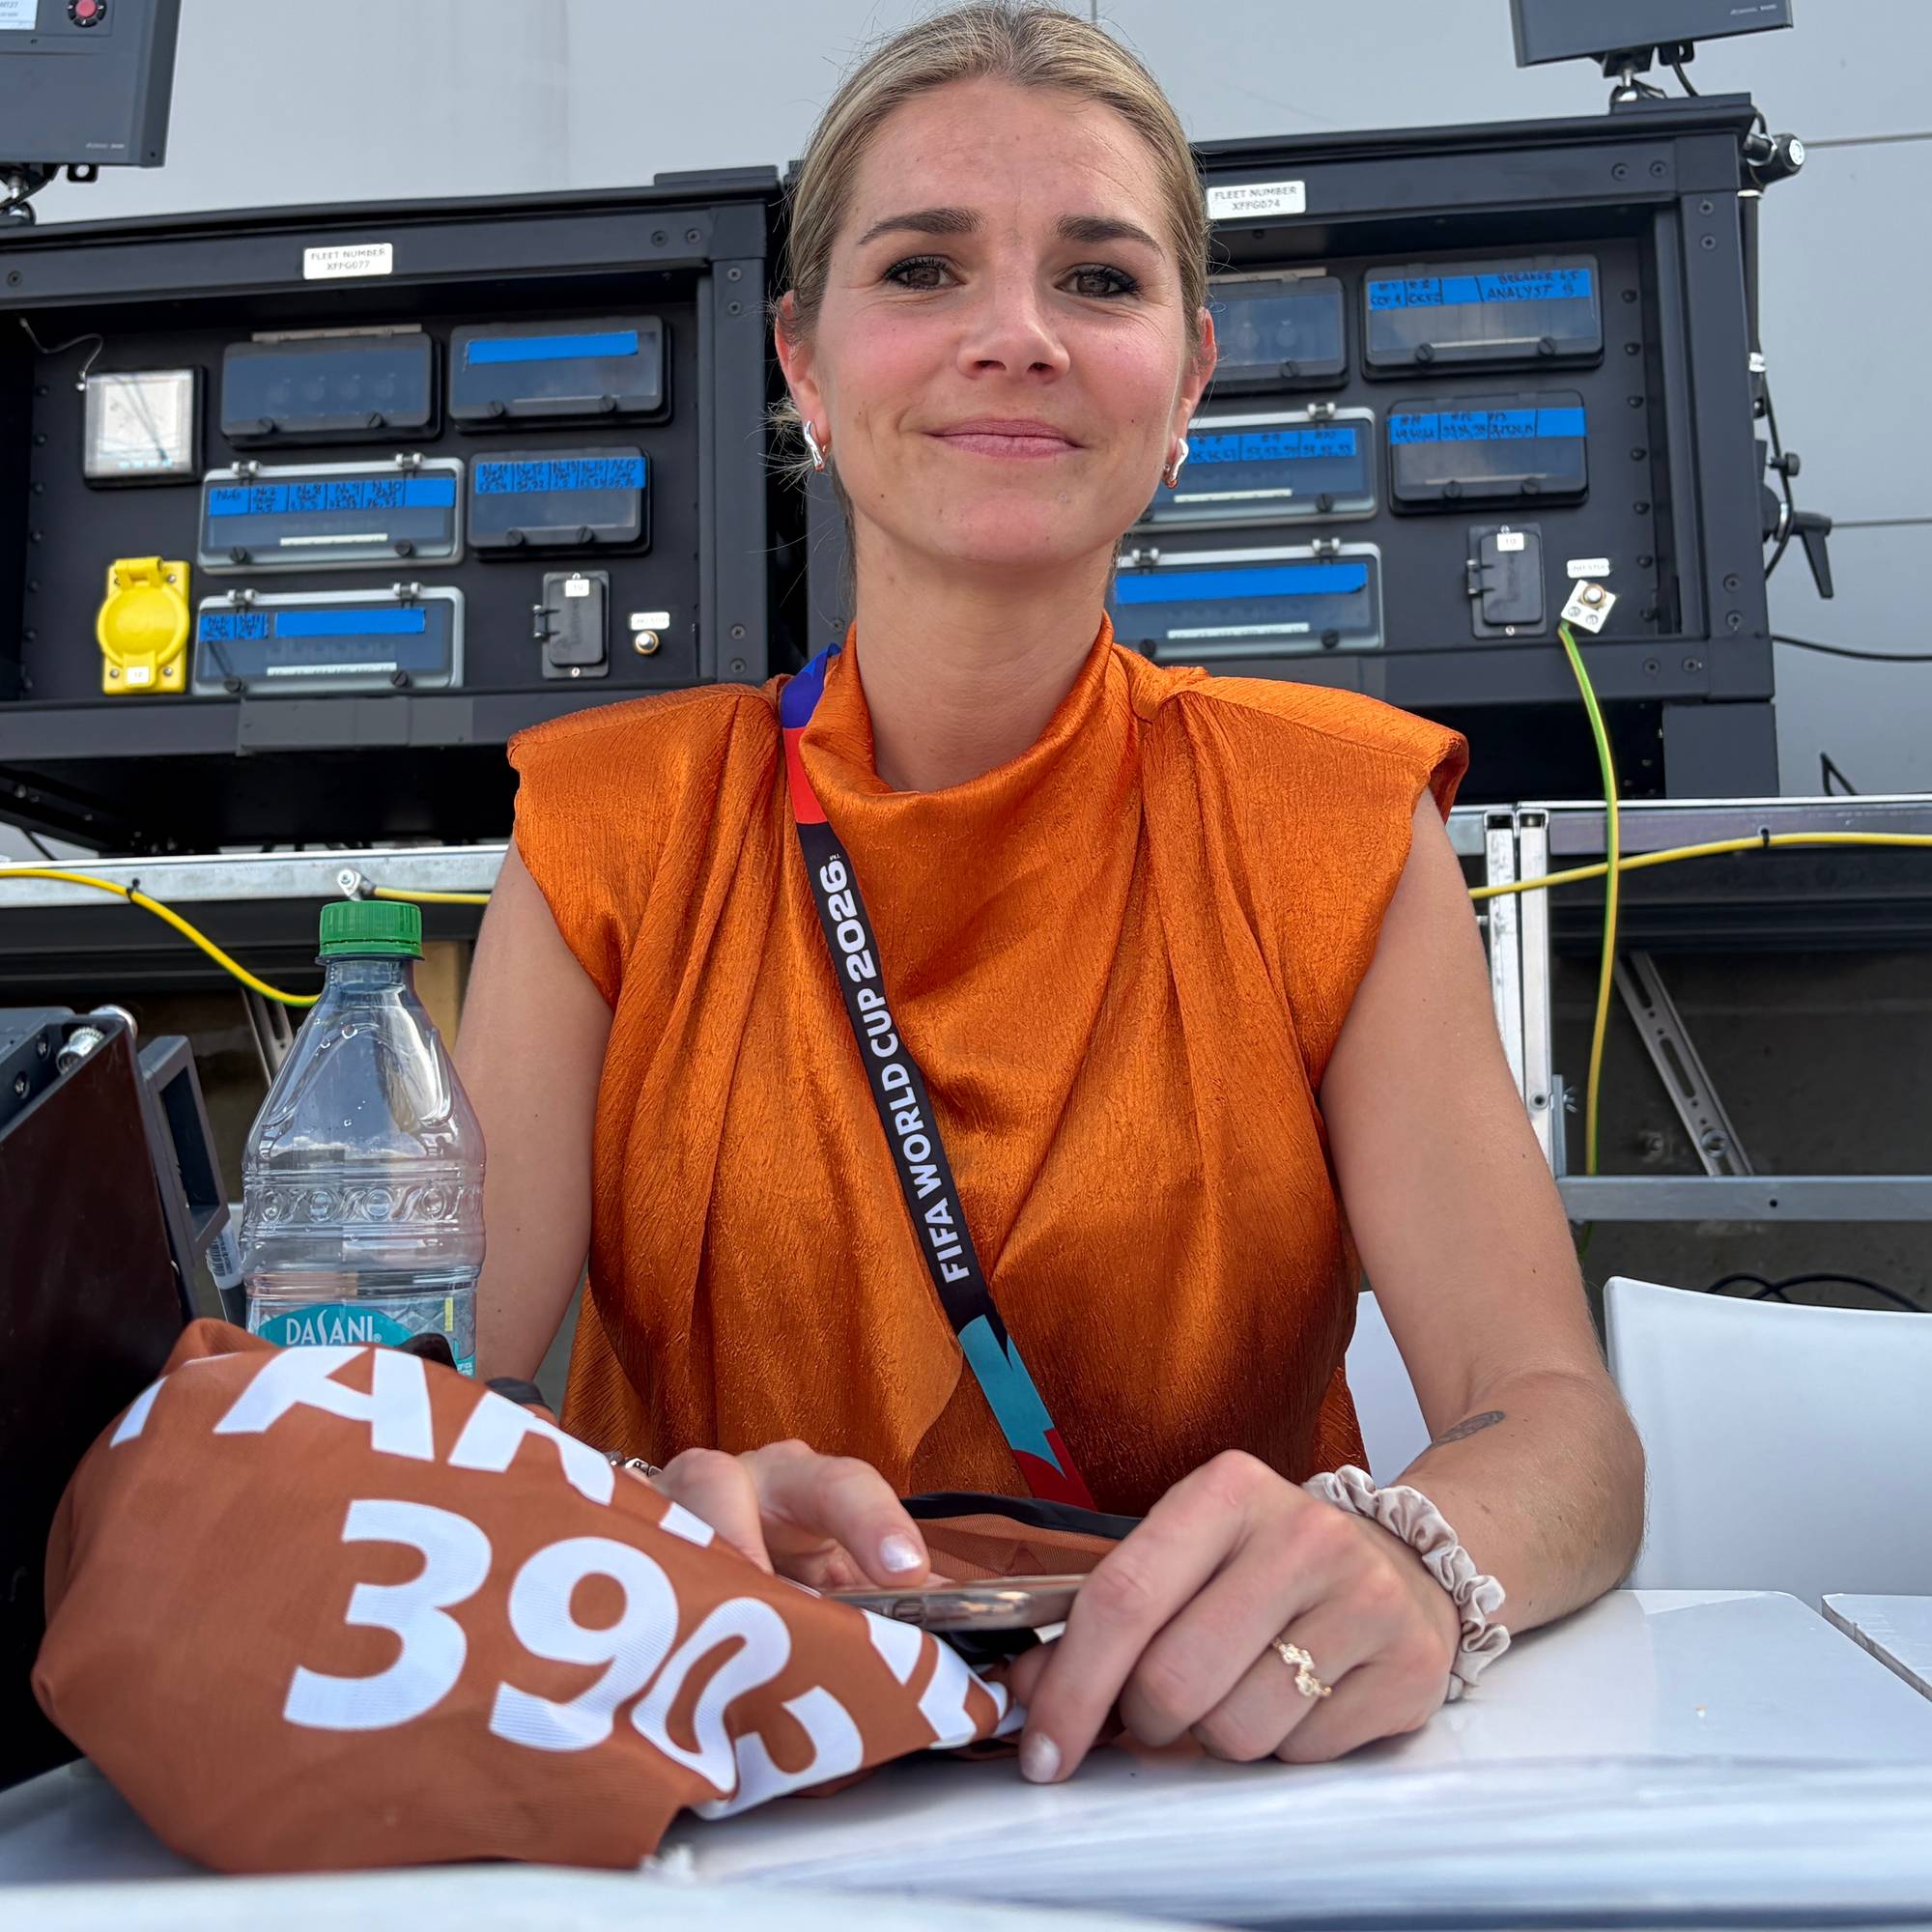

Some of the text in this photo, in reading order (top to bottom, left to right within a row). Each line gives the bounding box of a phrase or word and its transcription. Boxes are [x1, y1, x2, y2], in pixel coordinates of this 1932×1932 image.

[1214, 185, 1296, 200] FLEET NUMBER
[311, 248, 385, 261] FLEET NUMBER
[819, 860, 878, 982] 2026
[857, 987, 899, 1058] CUP
[881, 1063, 942, 1200] WORLD
[924, 1197, 970, 1284] FIFA
[285, 1309, 374, 1347] DASANI
